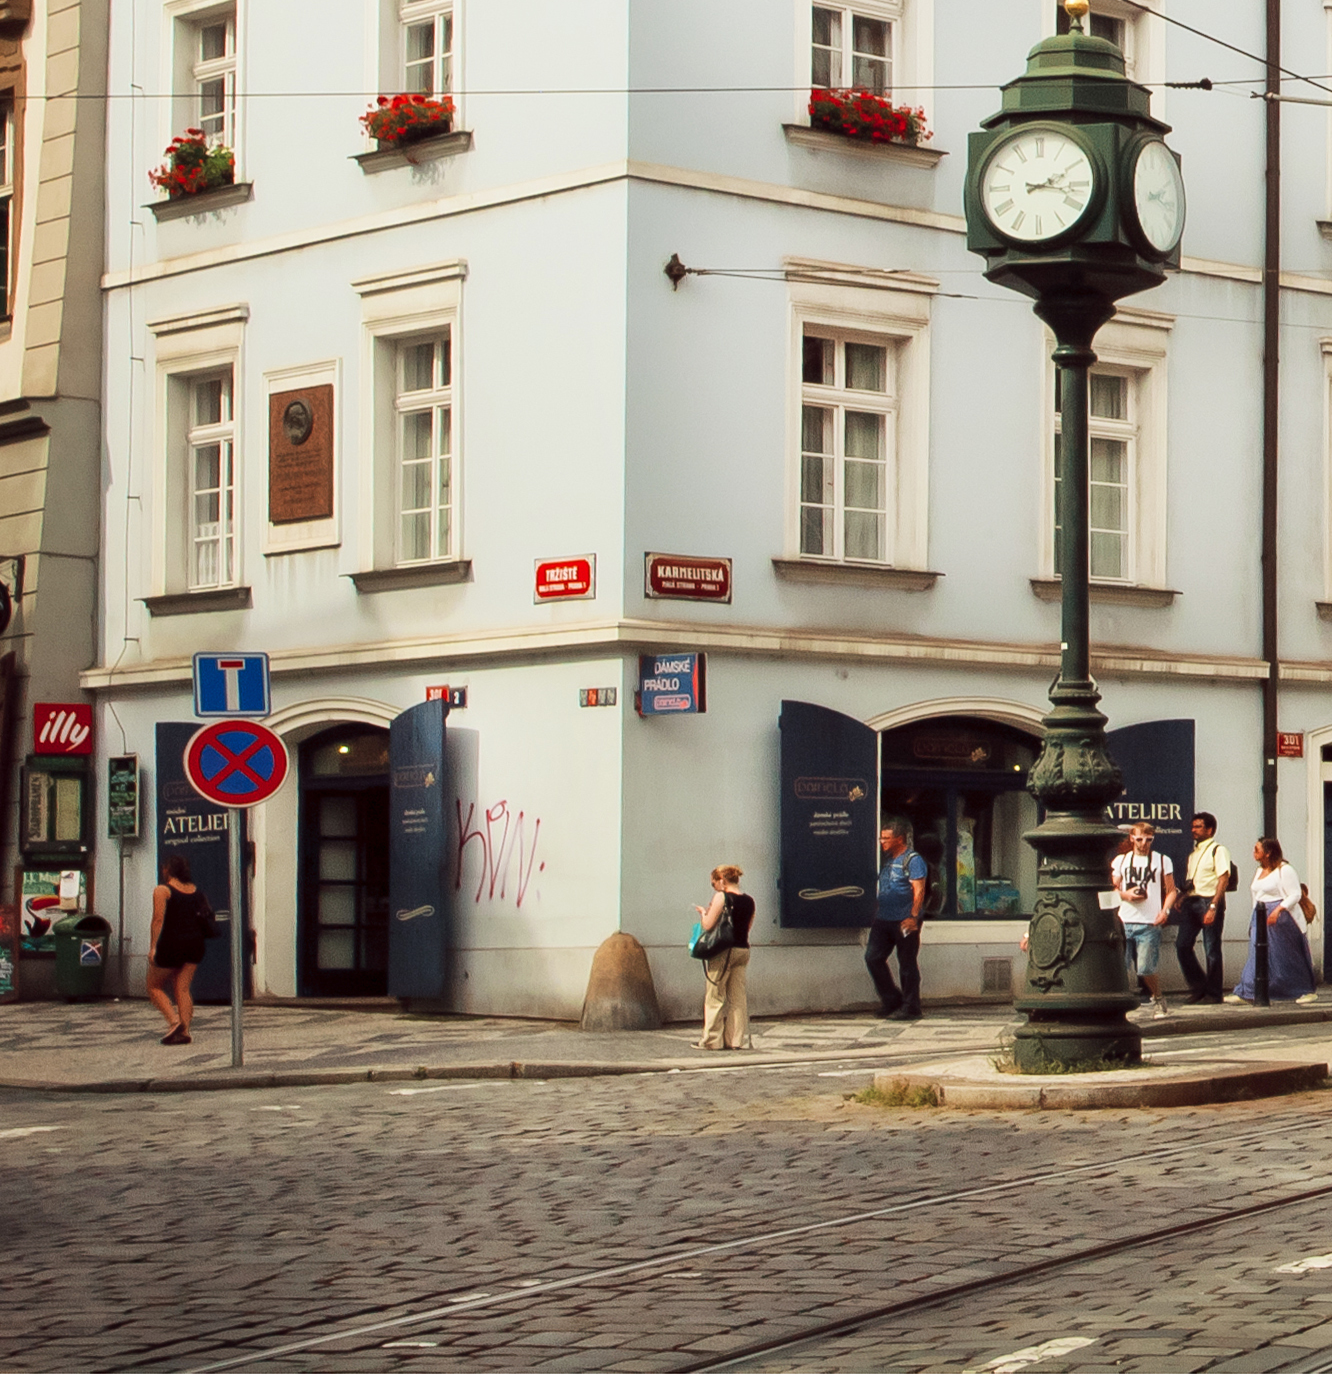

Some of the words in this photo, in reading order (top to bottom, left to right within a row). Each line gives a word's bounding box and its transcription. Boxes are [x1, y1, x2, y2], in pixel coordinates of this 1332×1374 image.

[545, 565, 578, 583] TRŽIŠTĚ
[657, 565, 725, 582] KARMELITSKÁ
[654, 657, 691, 675] DÁMSKÉ
[643, 677, 680, 691] PRÁDLO
[453, 691, 460, 705] 2
[39, 710, 90, 752] illy
